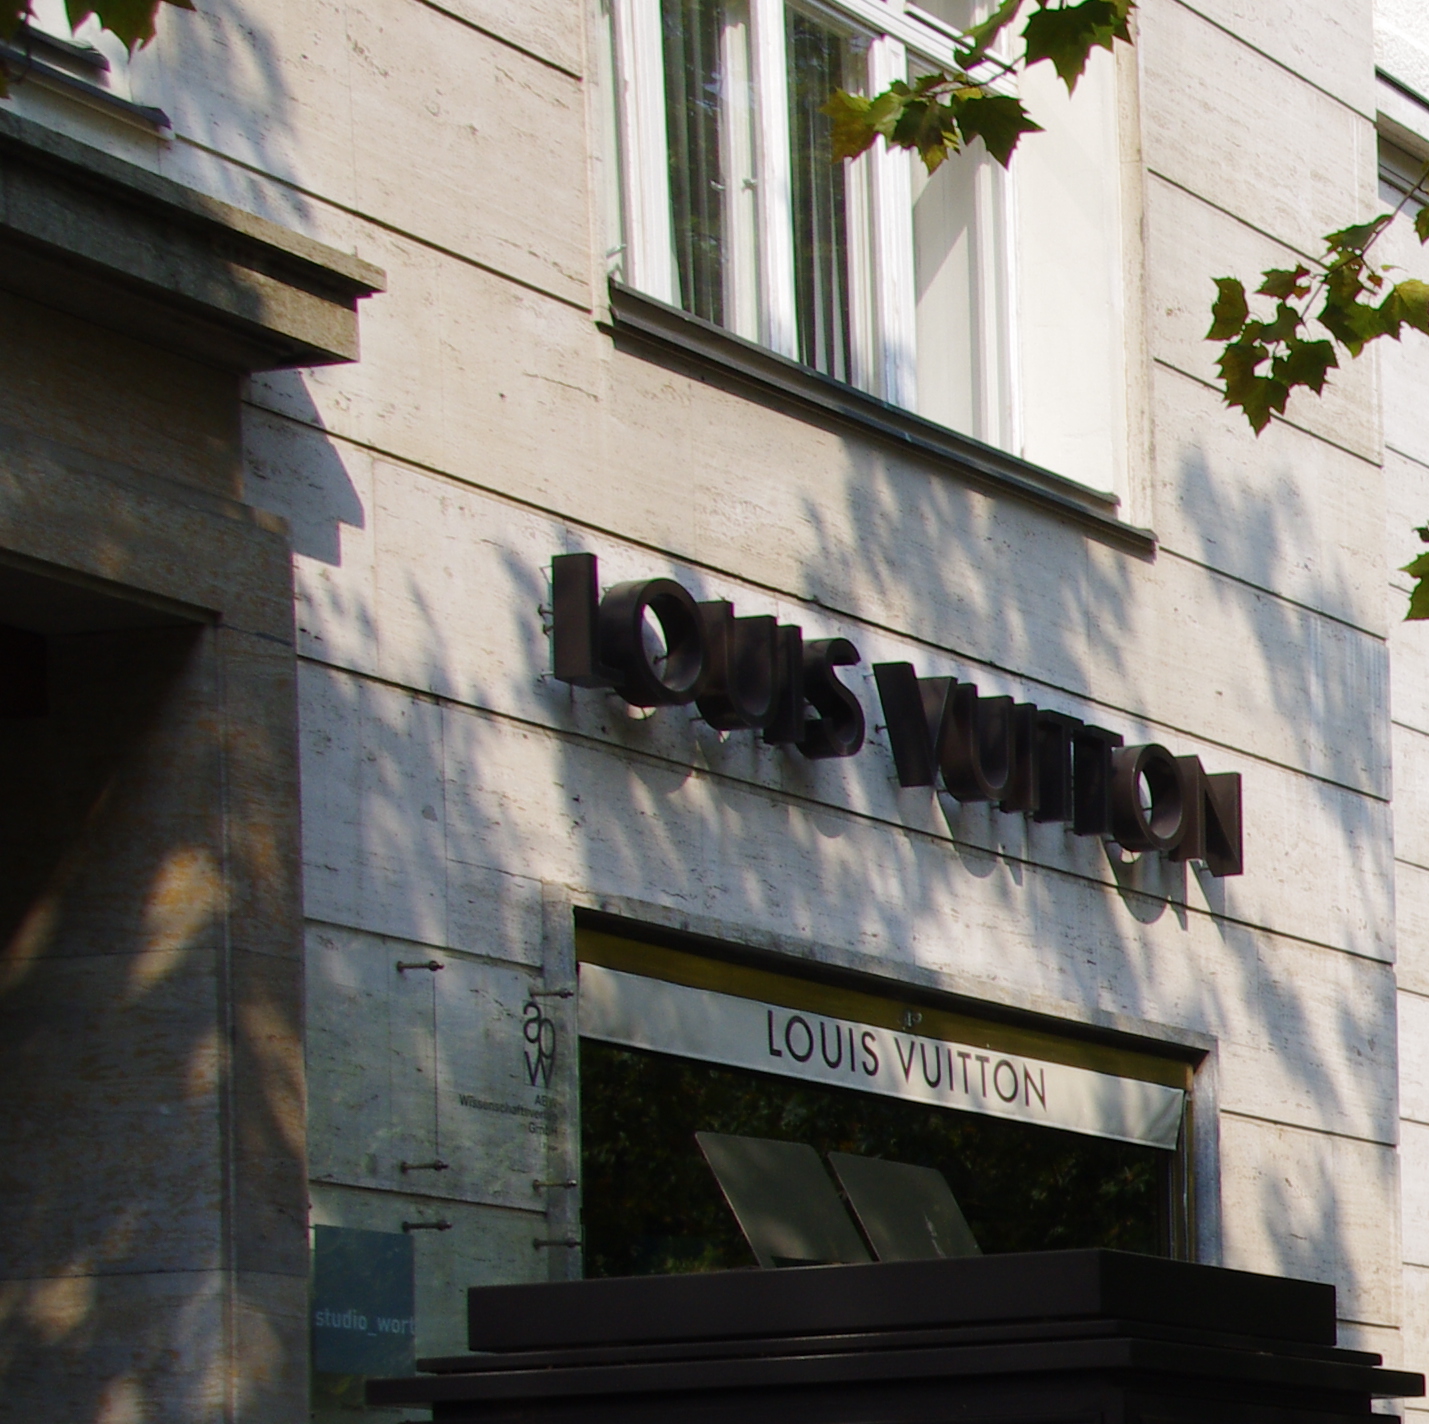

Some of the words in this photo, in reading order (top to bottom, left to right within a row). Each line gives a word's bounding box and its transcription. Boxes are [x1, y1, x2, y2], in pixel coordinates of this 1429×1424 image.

[553, 553, 865, 758] LOUIS
[873, 662, 1243, 877] VUITTON
[767, 1009, 879, 1077] LOUIS
[894, 1033, 1047, 1112] VUITTON
